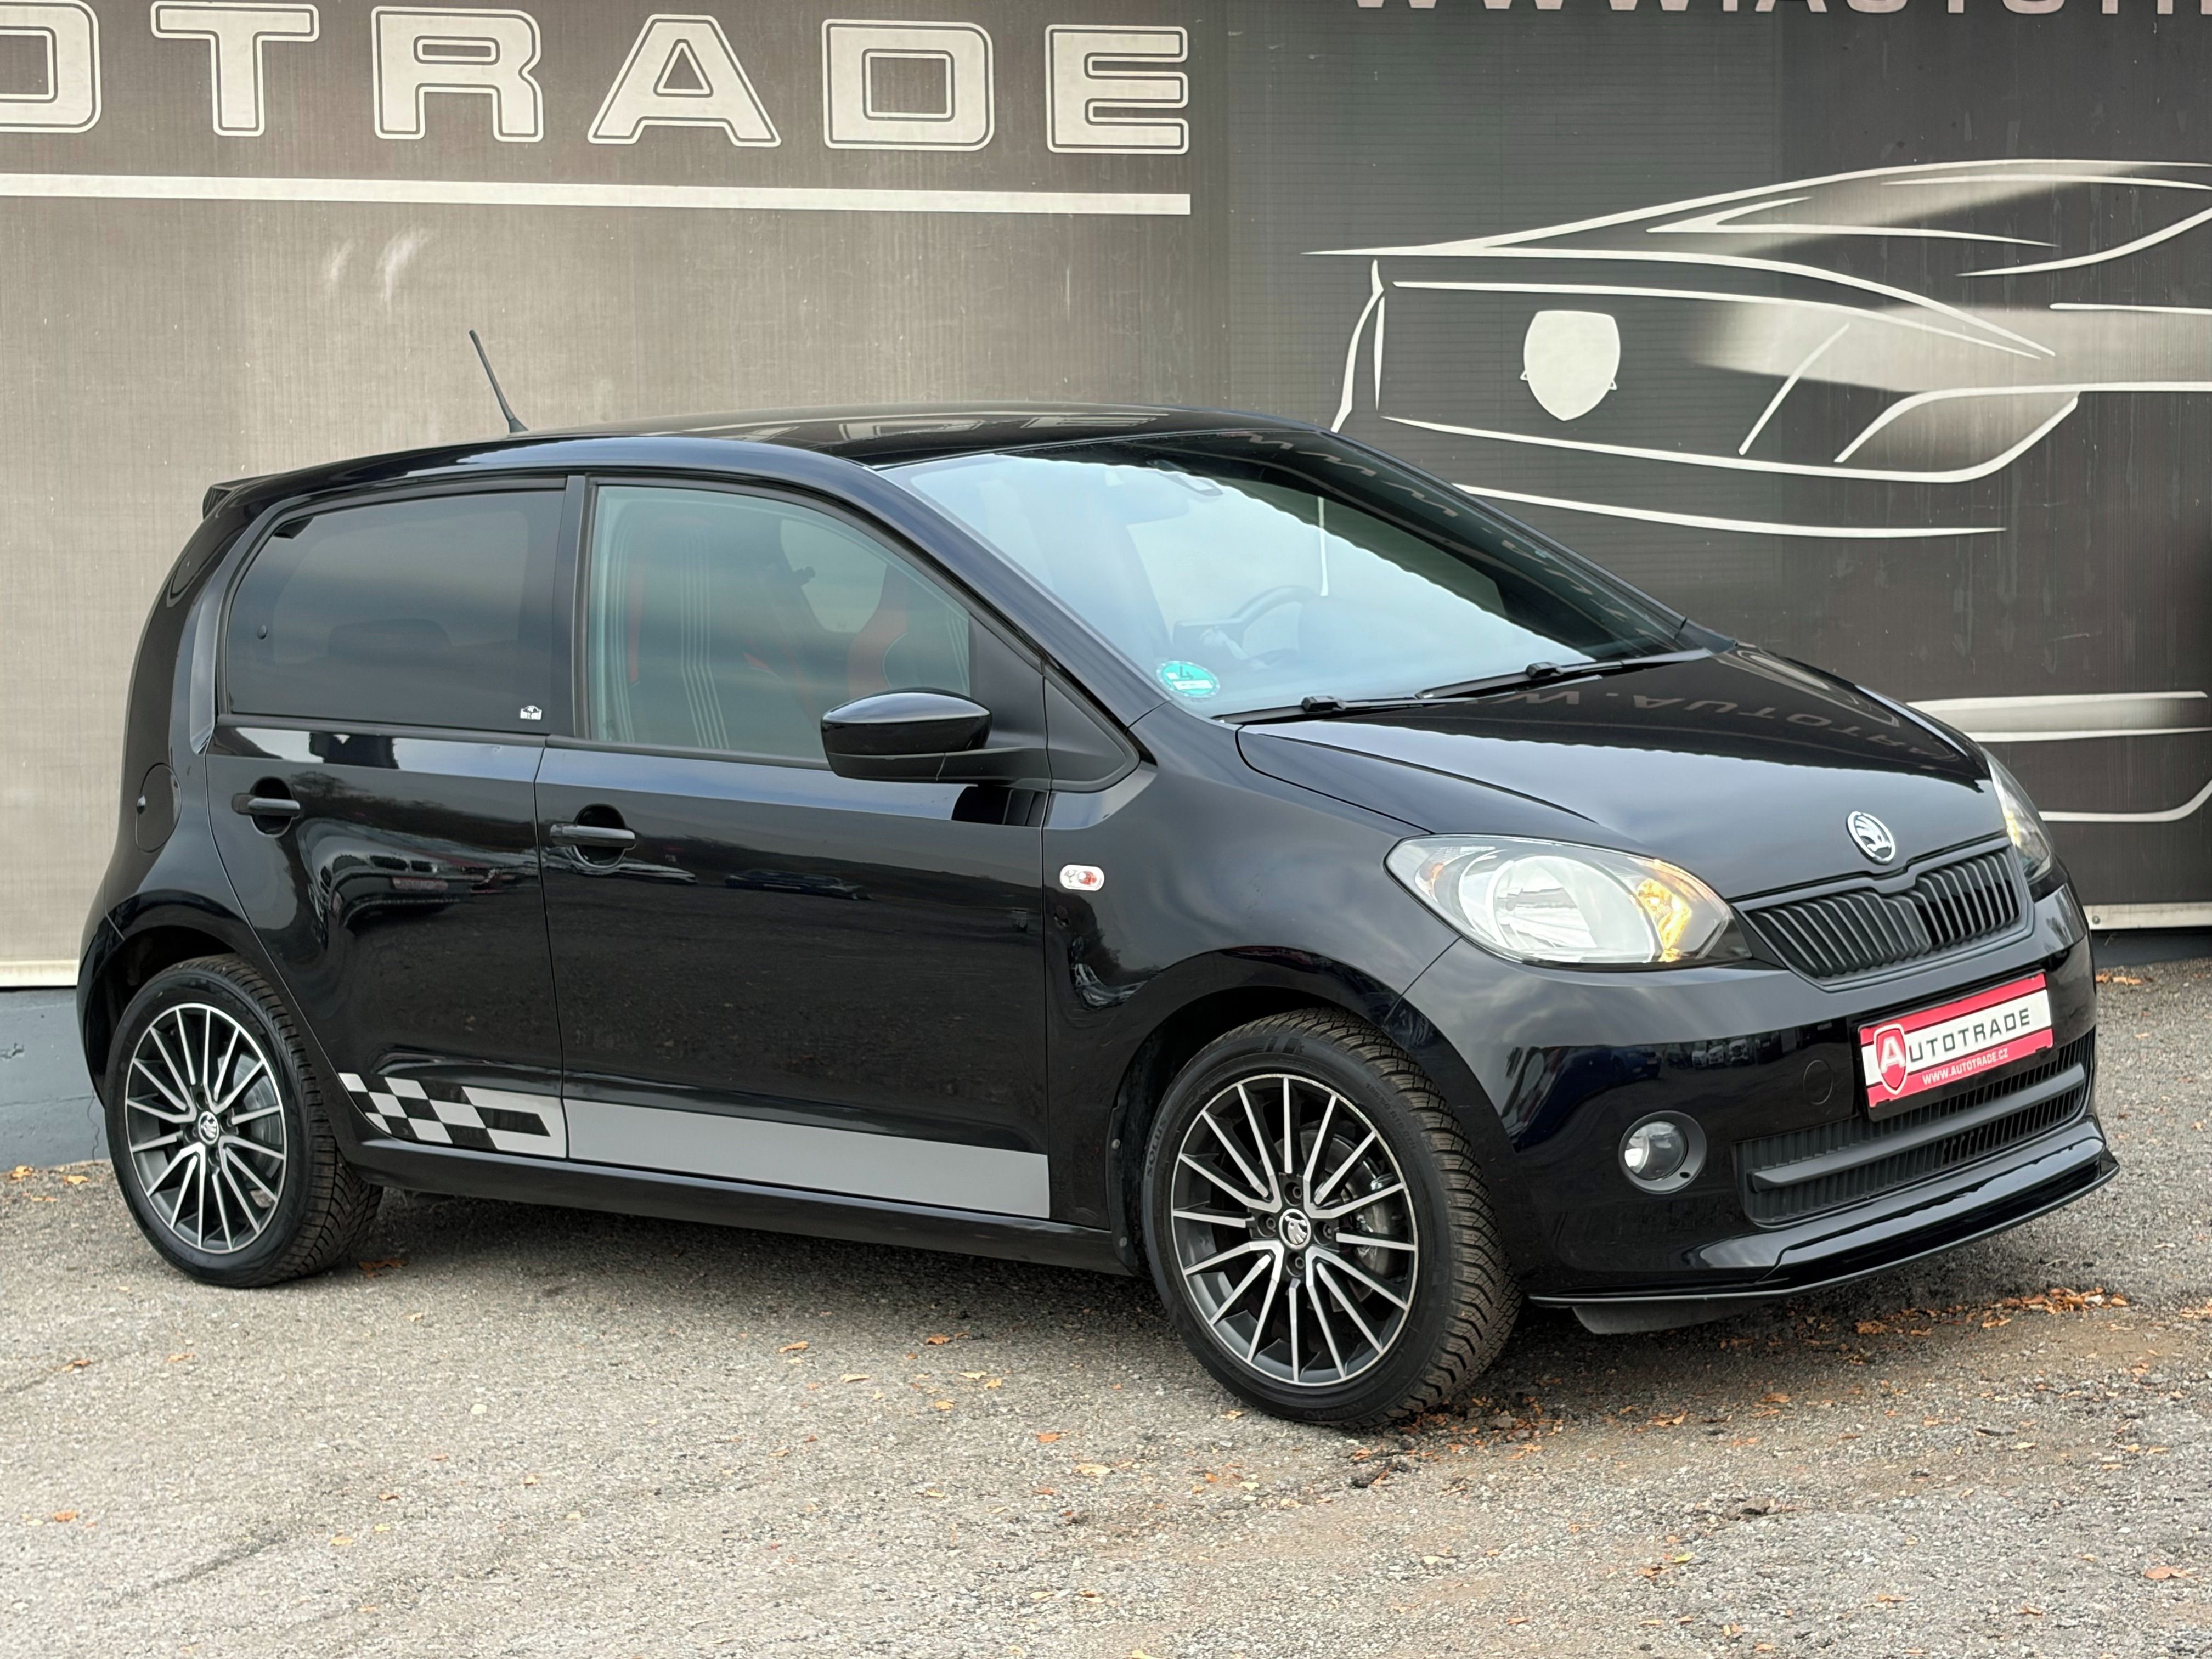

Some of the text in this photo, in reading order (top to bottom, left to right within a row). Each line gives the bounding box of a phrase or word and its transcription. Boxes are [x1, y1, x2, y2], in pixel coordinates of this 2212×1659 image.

[1879, 1007, 2030, 1073] AUTOTRADE
[1922, 1048, 2009, 1086] WWW.AUTOTRADE.CZ
[1147, 1116, 1167, 1178] SOLUS
